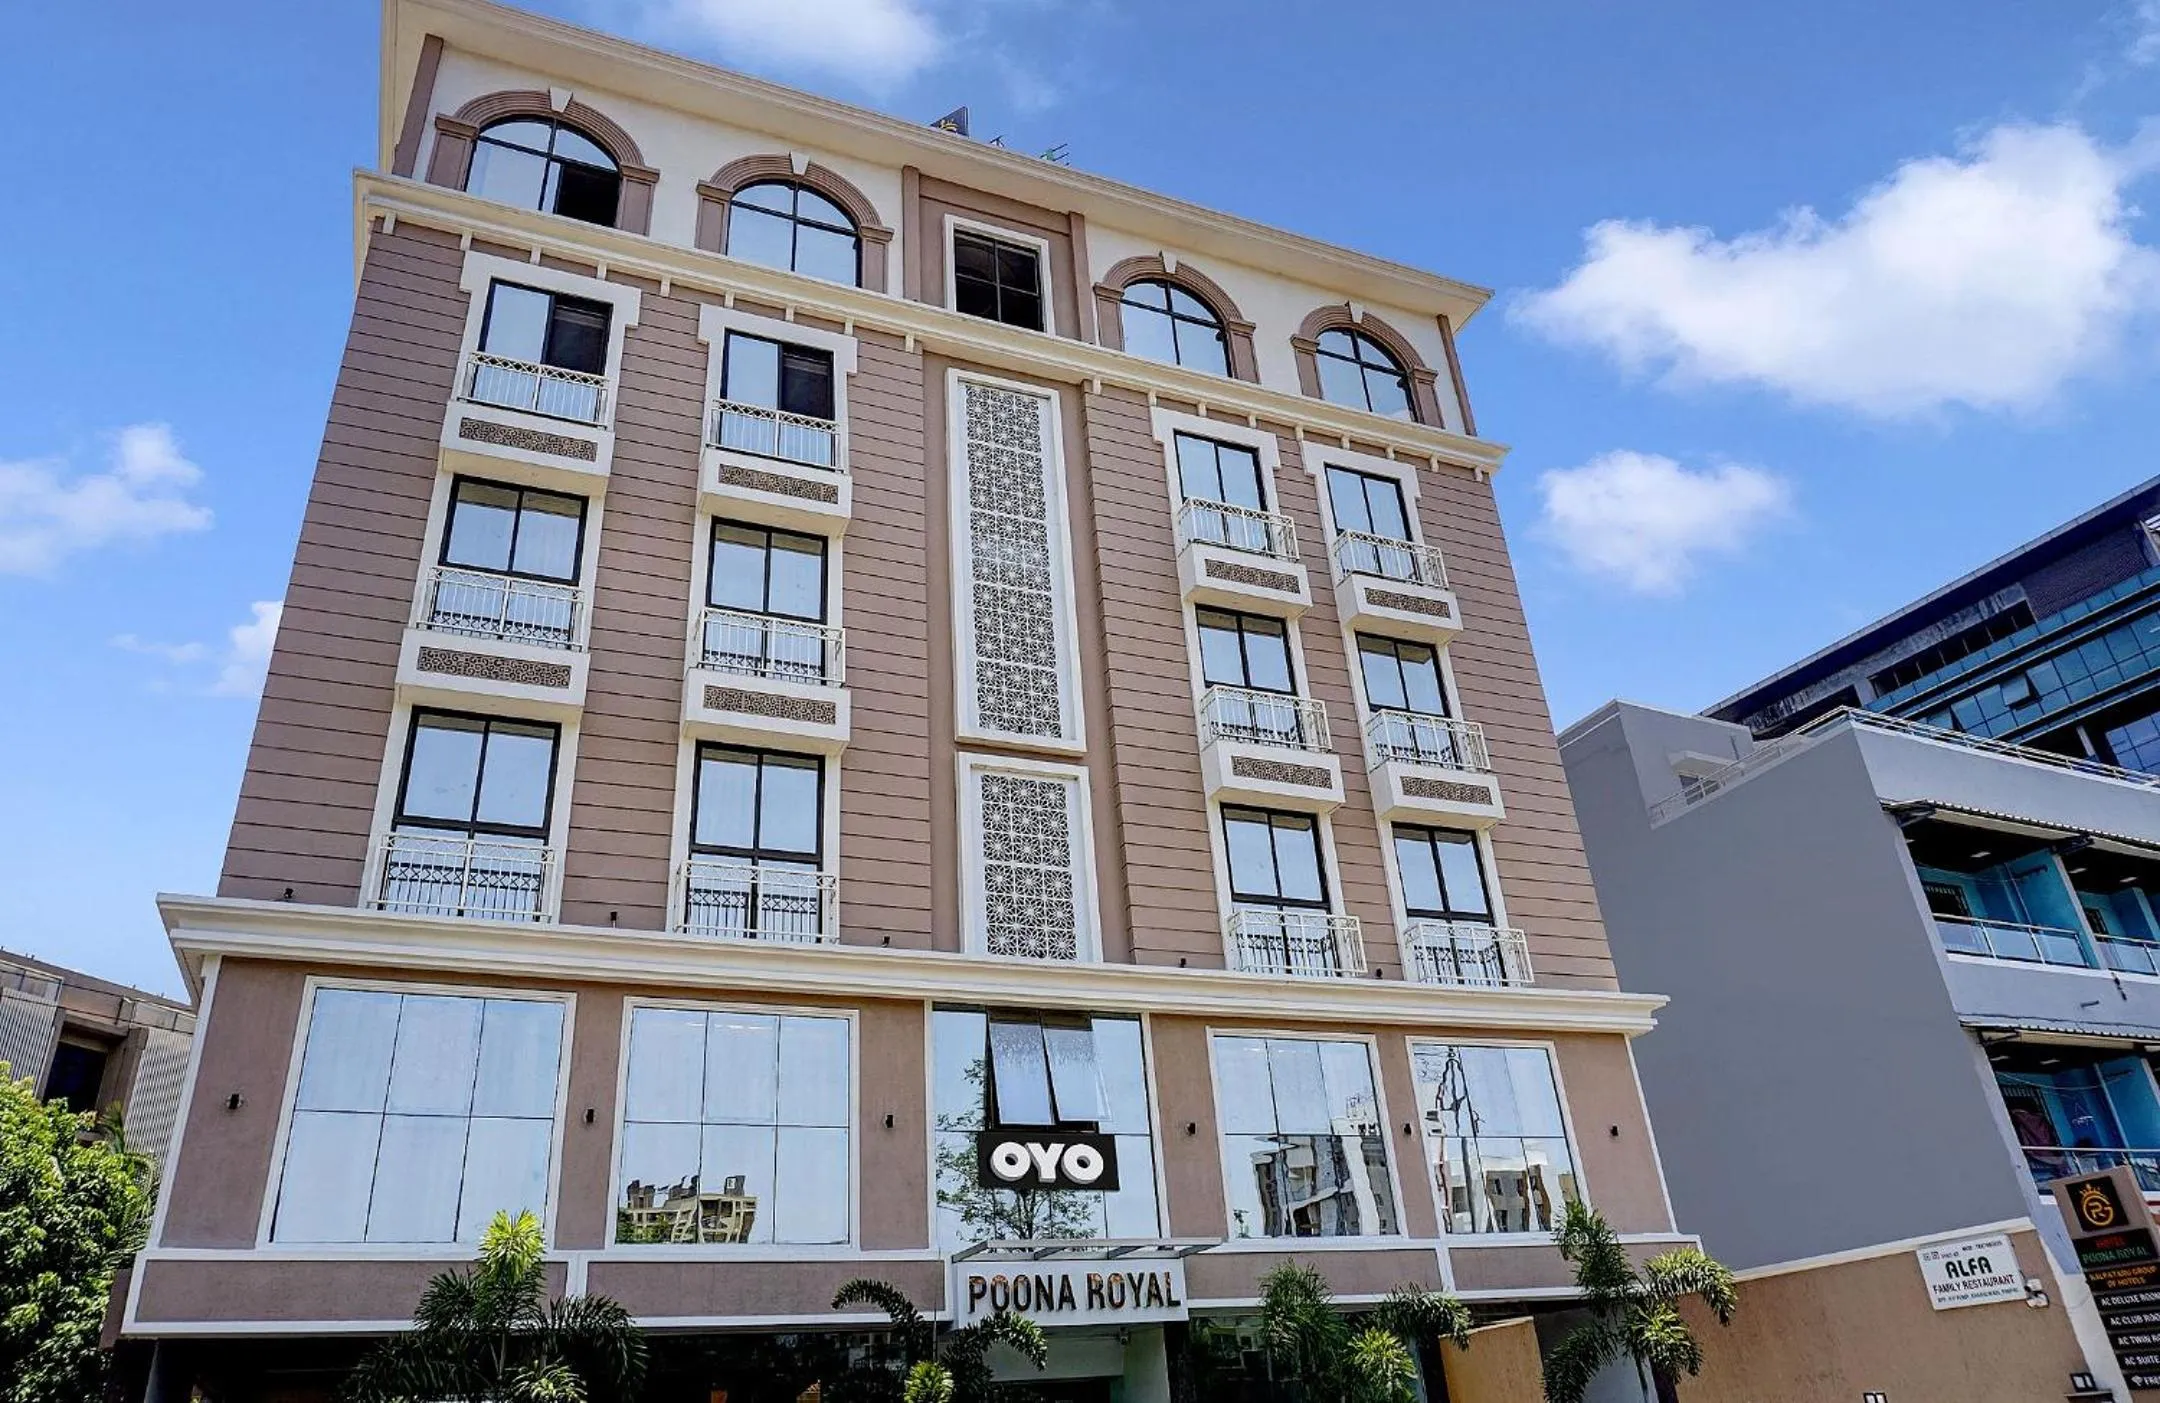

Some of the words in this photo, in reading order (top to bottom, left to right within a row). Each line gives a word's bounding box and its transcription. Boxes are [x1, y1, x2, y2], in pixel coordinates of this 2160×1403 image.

[990, 1141, 1104, 1184] OYO
[2082, 1251, 2116, 1264] POONA
[2116, 1246, 2149, 1259] ROYAL
[1945, 1255, 1993, 1279] ALFA
[968, 1274, 1077, 1314] POONA
[1086, 1271, 1182, 1310] ROYAL
[1933, 1281, 1962, 1294] FAMILY
[1962, 1274, 2016, 1291] RESTAURANT
[2102, 1297, 2112, 1306] AC
[2112, 1294, 2140, 1304] DELUXE
[2110, 1317, 2122, 1326] AC
[2122, 1315, 2143, 1325] CLUB
[2118, 1337, 2130, 1345] AC
[2129, 1335, 2152, 1344] TWIN
[2124, 1357, 2136, 1366] AC
[2136, 1355, 2160, 1365] SUITE
